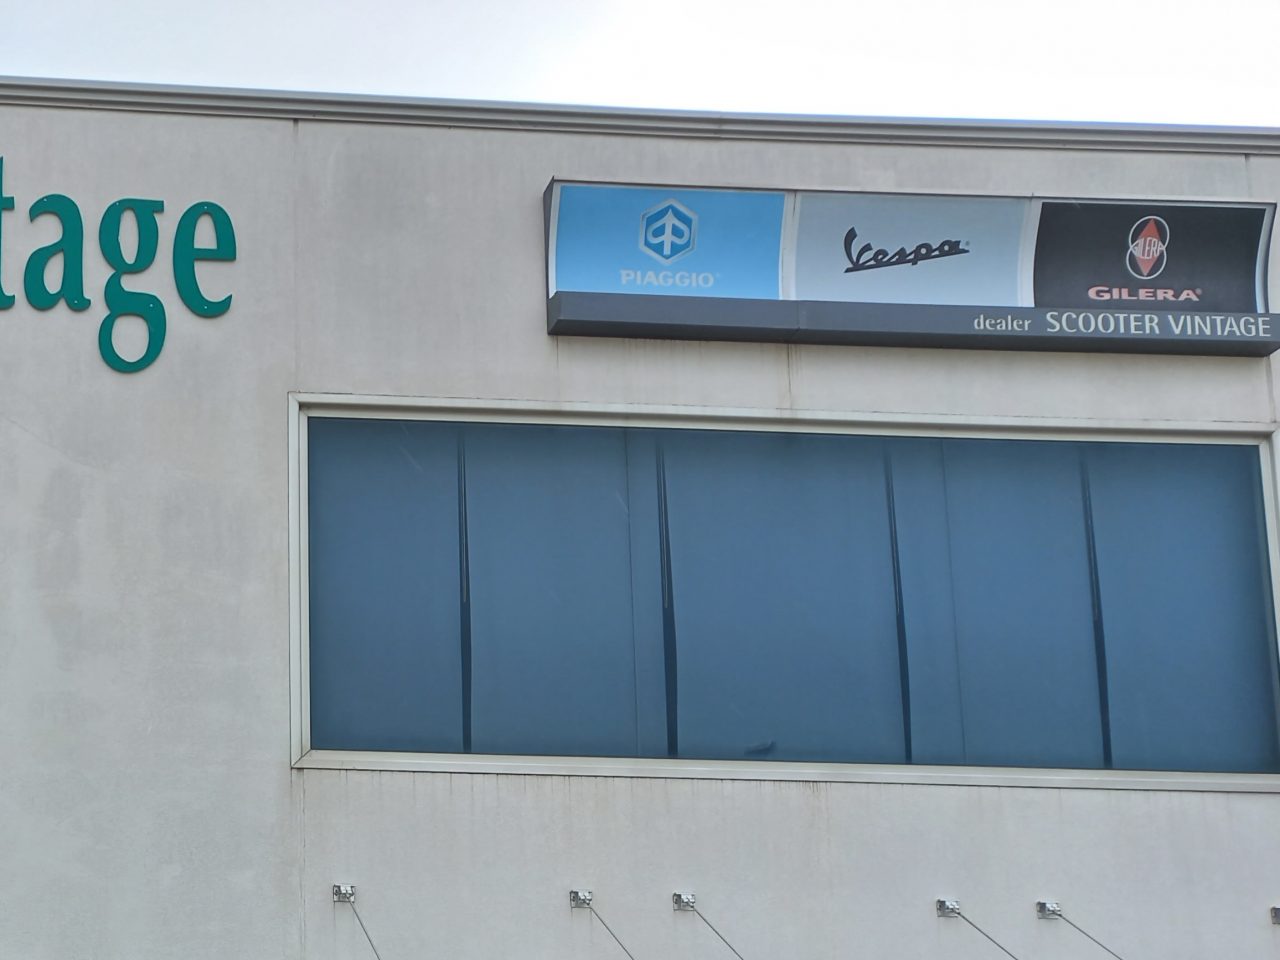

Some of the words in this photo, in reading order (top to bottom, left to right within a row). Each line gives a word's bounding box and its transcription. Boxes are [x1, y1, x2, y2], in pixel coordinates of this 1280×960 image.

[843, 226, 970, 273] Vespa
[1131, 237, 1165, 259] GILERA
[619, 269, 715, 288] PIAGGIO
[1087, 286, 1200, 301] GILERA
[973, 314, 1032, 331] dealer
[1045, 311, 1160, 335] SCOOTER
[1168, 314, 1272, 337] VINTAGE
